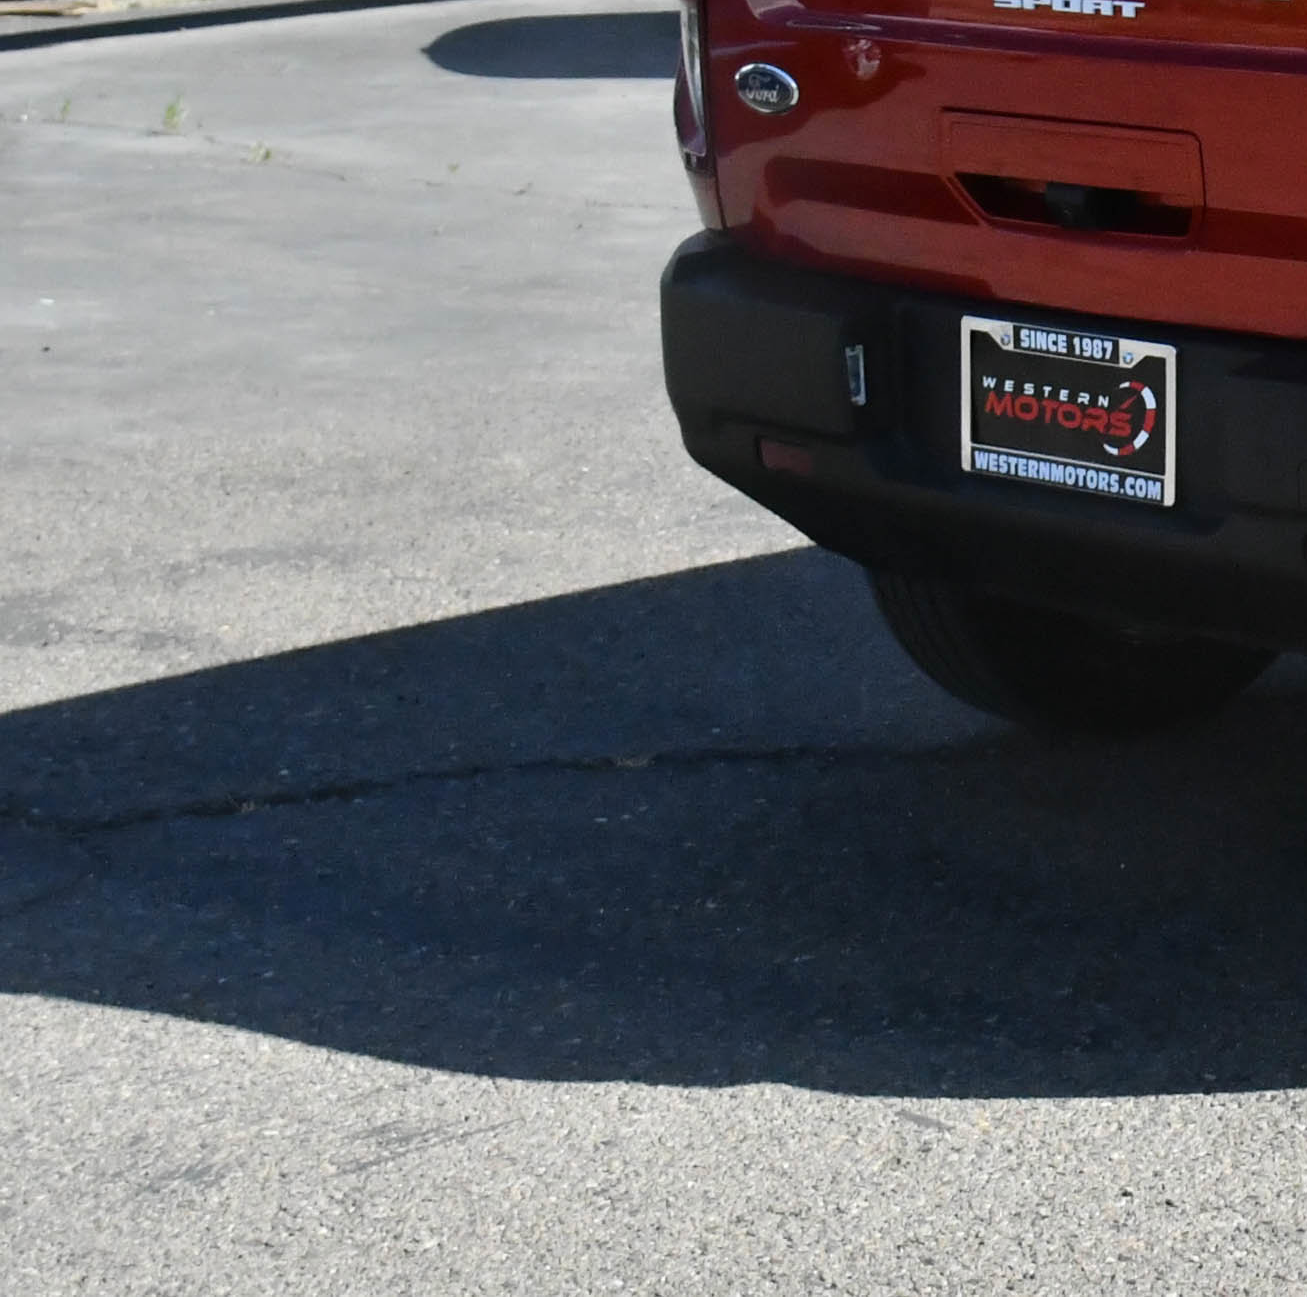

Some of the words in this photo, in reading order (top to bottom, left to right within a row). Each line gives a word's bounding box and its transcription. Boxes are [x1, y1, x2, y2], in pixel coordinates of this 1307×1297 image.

[745, 73, 780, 103] Ford
[1019, 328, 1068, 354] SINCE
[1073, 336, 1113, 360] 1987
[982, 375, 1110, 408] WESTERN
[984, 390, 1132, 438] MOTORS
[974, 450, 1162, 501] WESTERNMOTORS.COM
